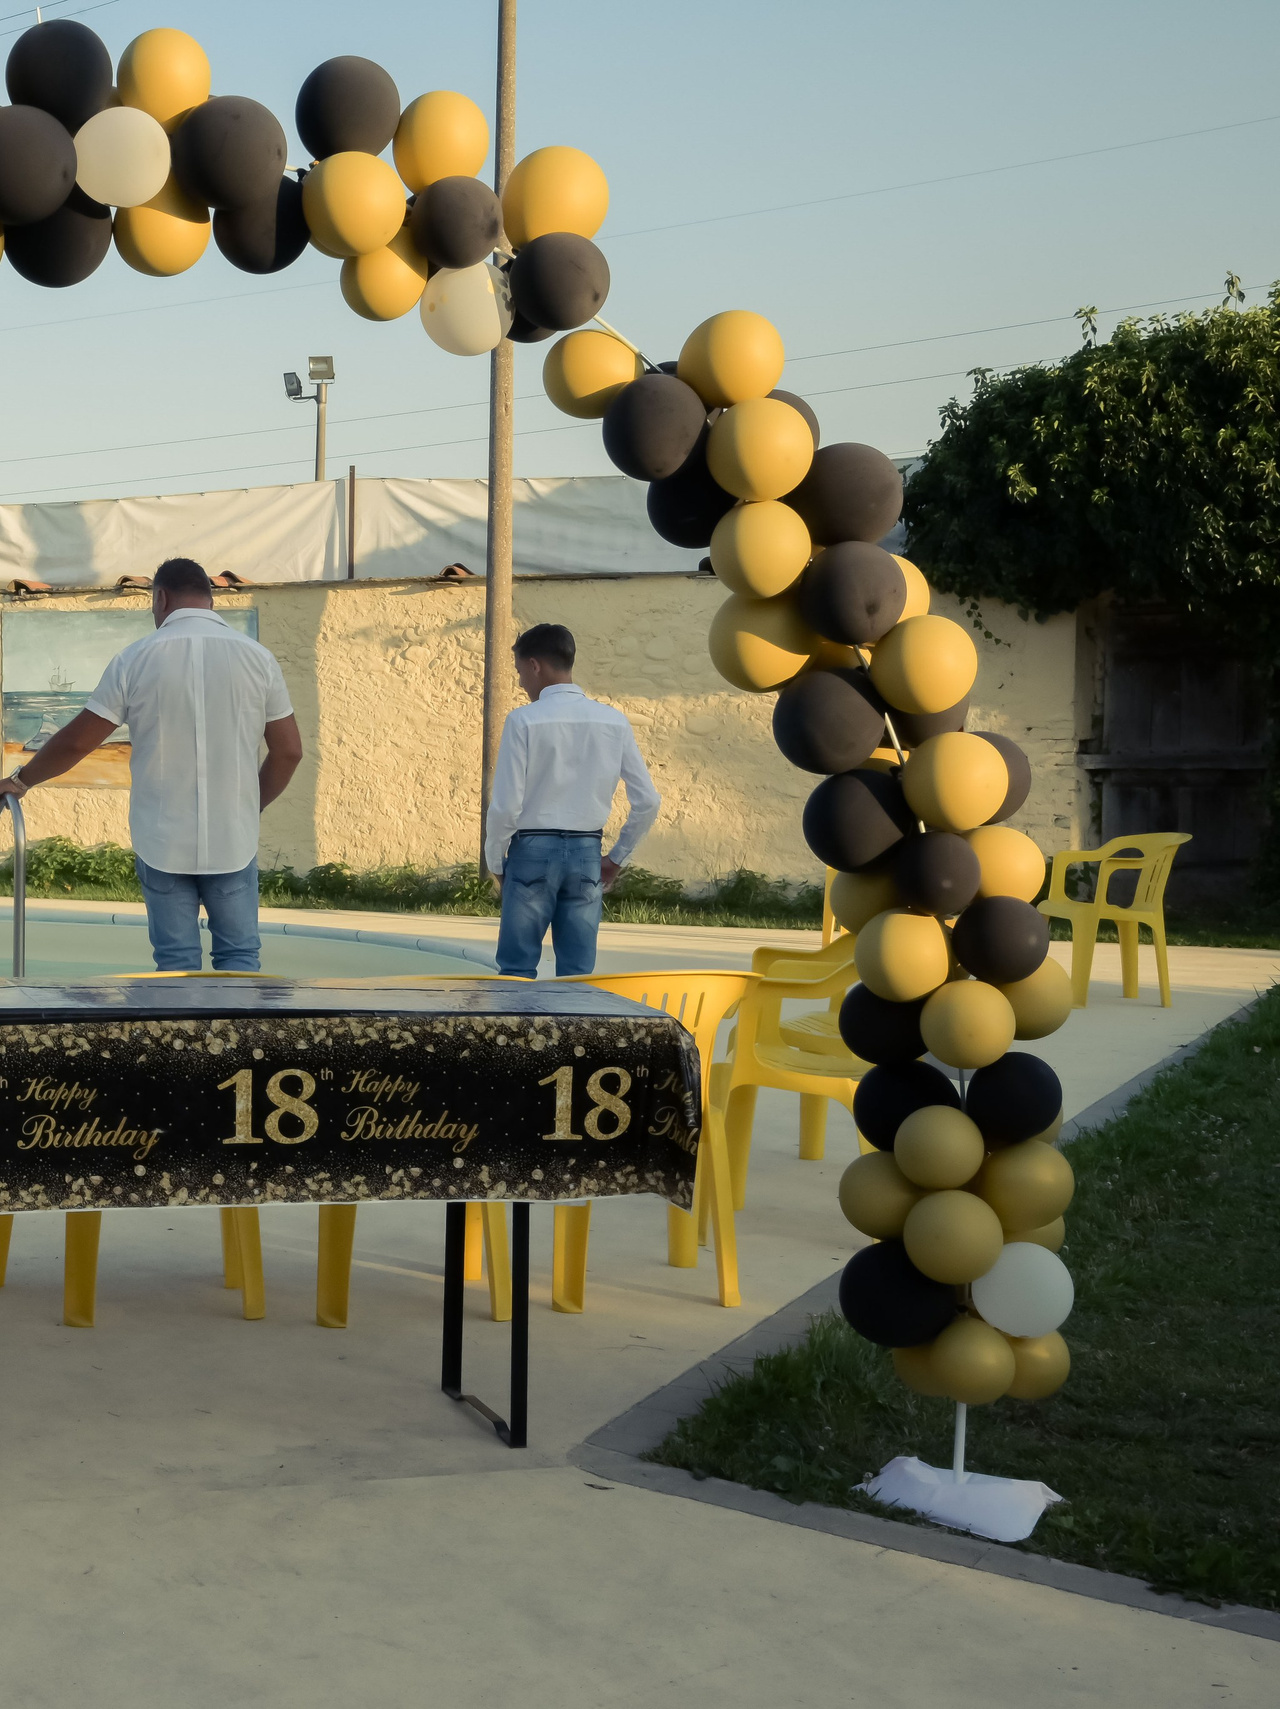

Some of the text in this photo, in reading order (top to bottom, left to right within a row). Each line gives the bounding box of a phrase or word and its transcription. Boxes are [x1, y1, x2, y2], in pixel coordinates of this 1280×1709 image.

[16, 1076, 98, 1111] Happy
[341, 1069, 421, 1103] Happy
[17, 1115, 160, 1160] Birthday
[340, 1106, 480, 1152] Birthday
